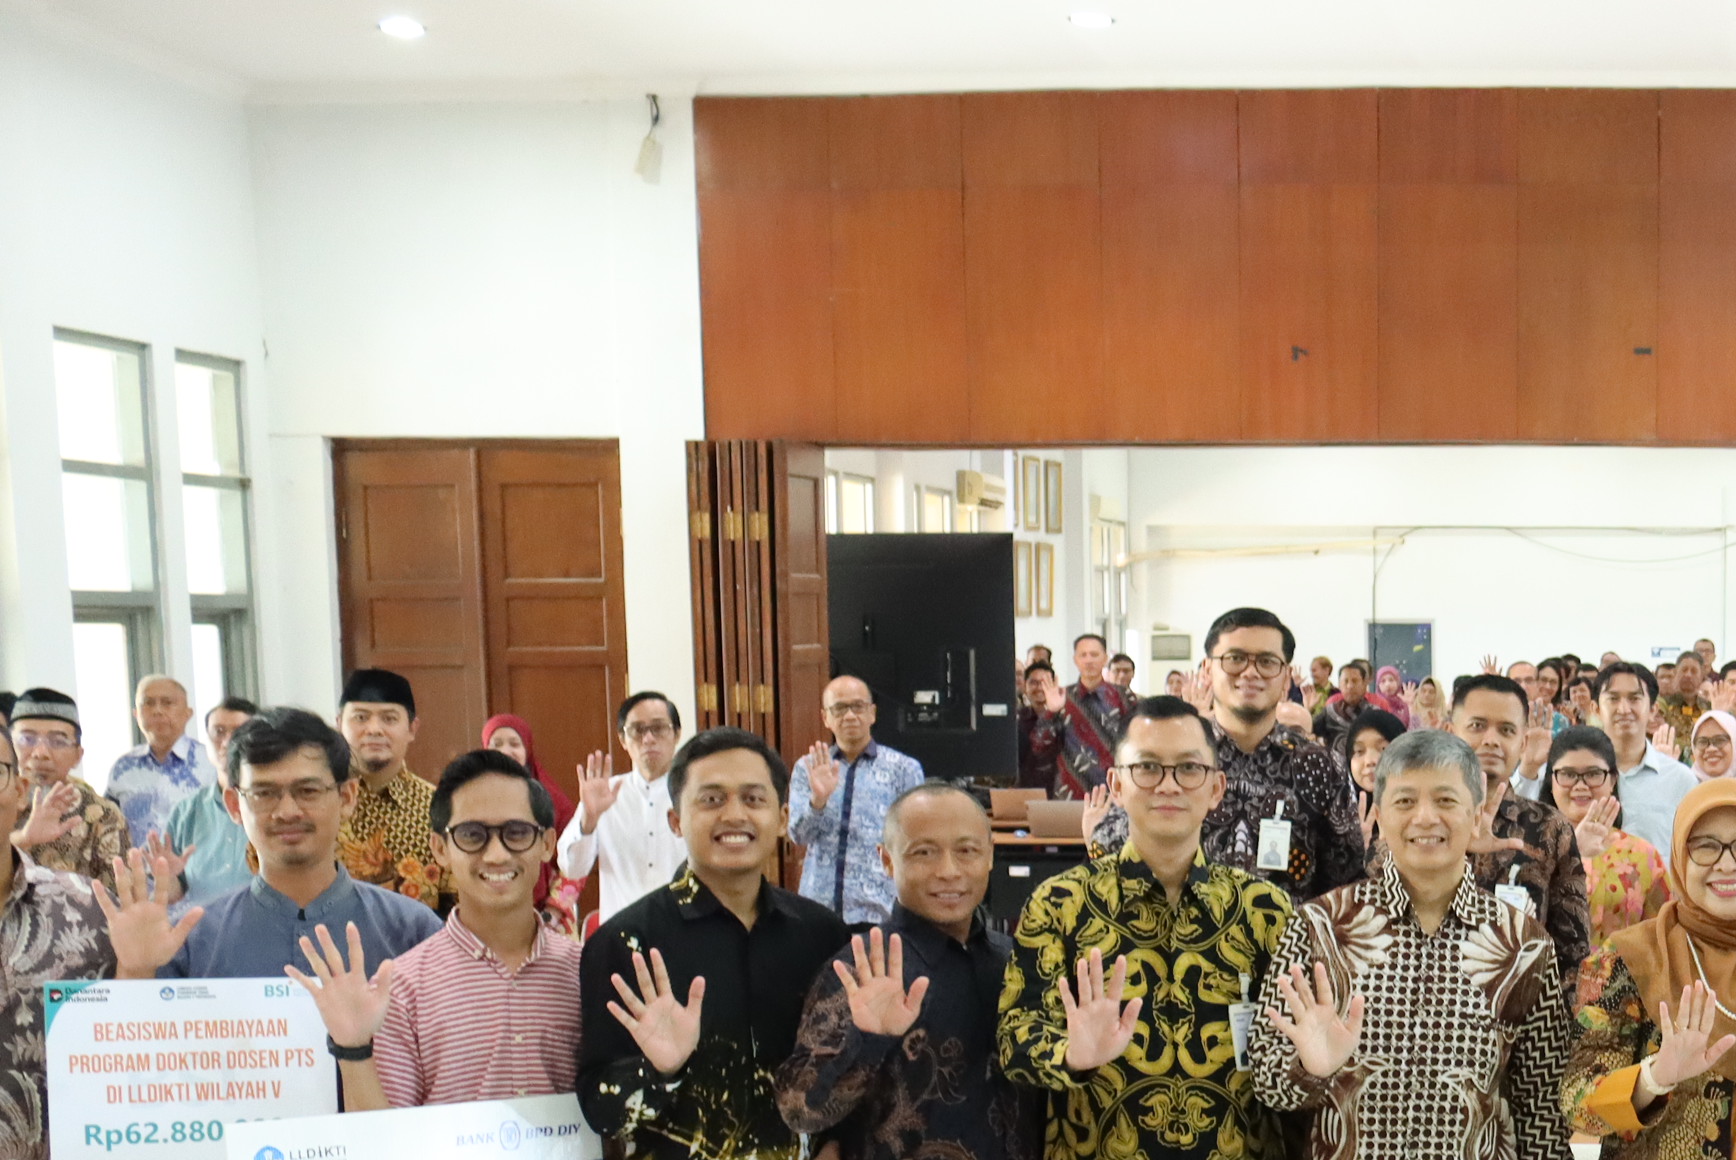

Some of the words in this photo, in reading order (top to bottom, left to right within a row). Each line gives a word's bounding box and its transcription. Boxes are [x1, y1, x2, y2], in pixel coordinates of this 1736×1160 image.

[264, 984, 289, 997] BSI
[94, 1021, 178, 1041] BEASISWA
[184, 1019, 288, 1039] PEMBIAYAAN
[69, 1053, 150, 1073] PROGRAM
[156, 1051, 221, 1071] DOKTOR
[227, 1050, 279, 1069] DOSEN
[285, 1048, 315, 1067] PTS
[107, 1085, 122, 1104] DI
[128, 1083, 190, 1103] LLDIKTI
[195, 1081, 267, 1101] WILAYAH
[272, 1081, 280, 1098] V
